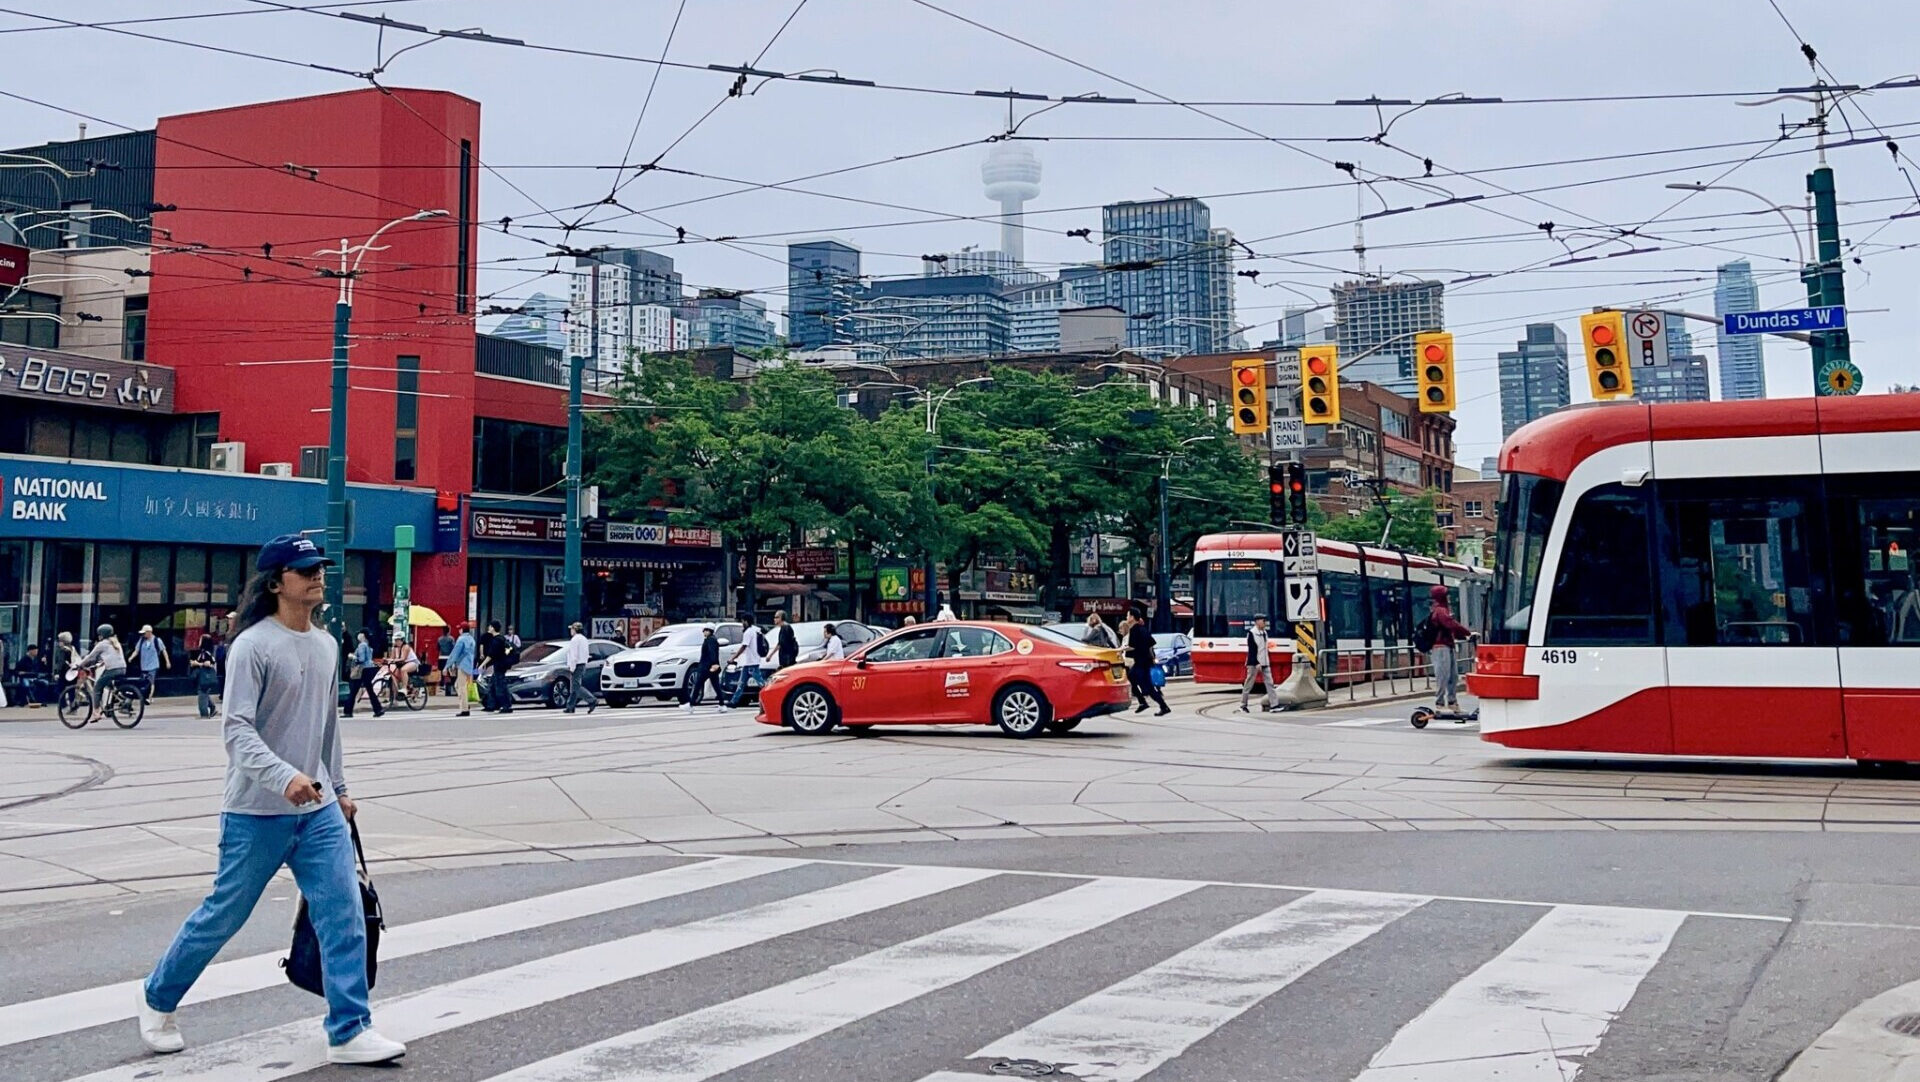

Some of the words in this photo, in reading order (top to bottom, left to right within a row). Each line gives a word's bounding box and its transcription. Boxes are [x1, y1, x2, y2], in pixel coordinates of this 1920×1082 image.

[1737, 313, 1799, 329] Dundas
[1804, 311, 1813, 319] St
[1815, 309, 1831, 324] W
[1273, 420, 1302, 432] TRANSIT
[1276, 433, 1302, 446] SIGNAL
[14, 476, 107, 500] NATIONAL
[12, 500, 67, 521] BANK
[610, 532, 634, 540] SHOPPE
[763, 555, 785, 568] Canada
[1541, 650, 1577, 664] 4619
